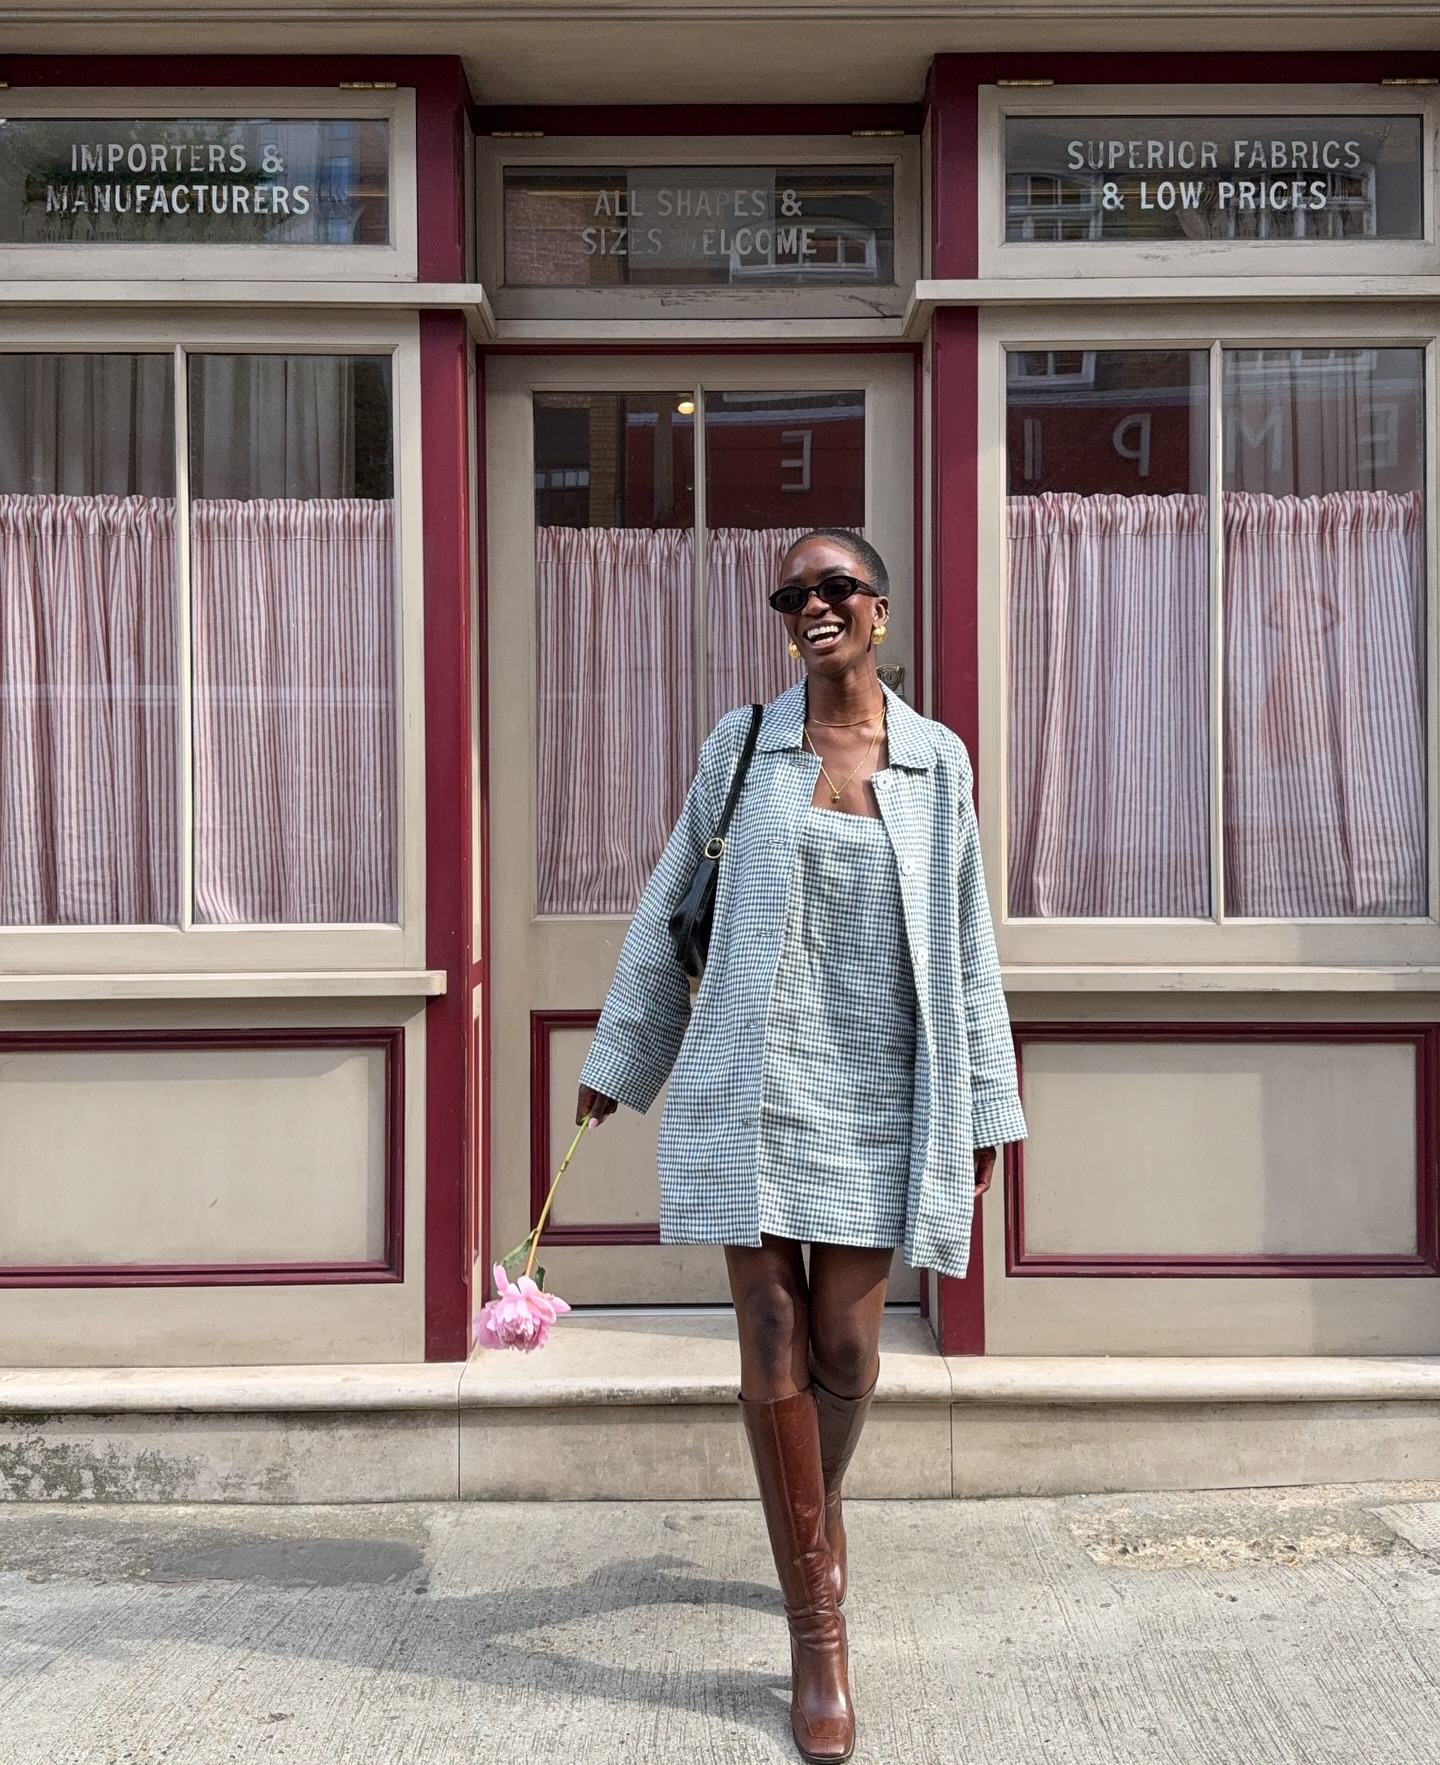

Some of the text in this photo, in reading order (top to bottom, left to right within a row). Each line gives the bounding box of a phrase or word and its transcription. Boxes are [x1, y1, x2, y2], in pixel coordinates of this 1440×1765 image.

[70, 143, 285, 174] IMPORTERS &
[1067, 140, 1361, 171] SUPERIOR FABRICS
[45, 184, 311, 216] MANUFACTURERS
[594, 189, 803, 218] ALL SHAPES &
[1102, 181, 1327, 212] & LOW PRICES
[581, 228, 818, 256] SIZES ELCOME
